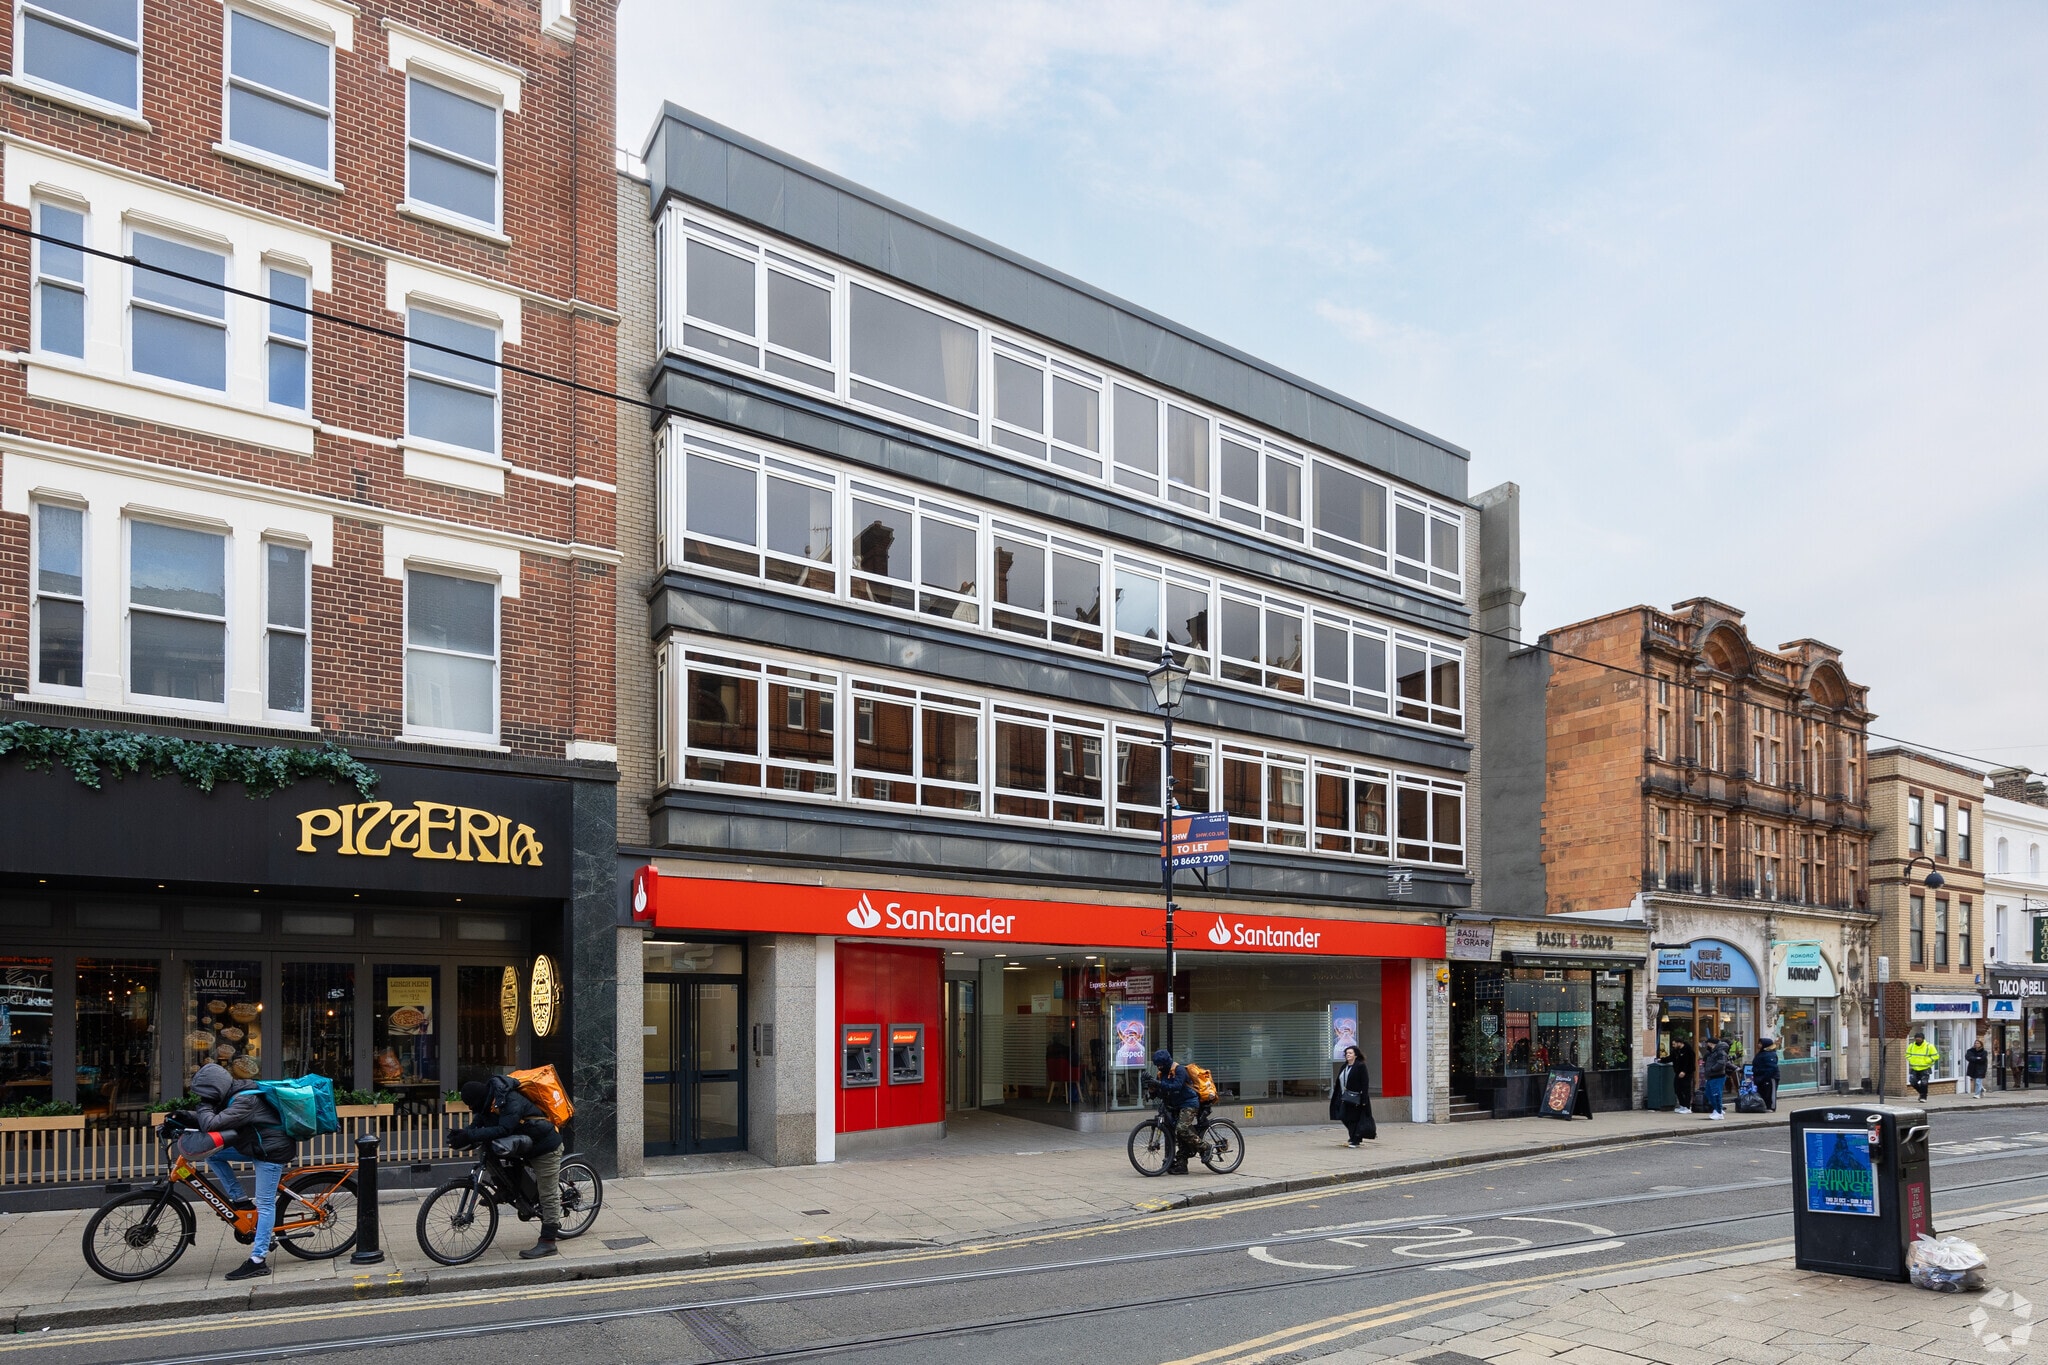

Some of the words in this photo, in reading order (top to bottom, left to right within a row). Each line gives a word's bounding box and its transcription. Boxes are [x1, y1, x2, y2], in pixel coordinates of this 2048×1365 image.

[296, 801, 544, 867] PIZZERIA
[1171, 832, 1188, 841] SHW
[1177, 845, 1190, 854] TO
[1192, 842, 1209, 852] LET
[1180, 856, 1201, 865] 8662
[1202, 854, 1225, 863] 2700
[885, 902, 1016, 934] Santander
[1233, 923, 1321, 948] Santander
[1457, 929, 1479, 938] BASIL
[1463, 938, 1490, 948] GRAPE
[1536, 931, 1567, 948] BASIL
[1570, 932, 1578, 948] &
[1581, 934, 1614, 950] GRAPE
[206, 969, 225, 979] LET
[225, 970, 236, 979] IT
[1690, 960, 1731, 981] NERO
[1788, 966, 1819, 982] KOKORO
[193, 979, 247, 988] SNOW(BALL)
[1108, 980, 1128, 988] Banking
[1998, 980, 2019, 995] TACO
[2028, 981, 2047, 995] BELL
[1117, 1049, 1144, 1059] Respect
[1827, 1112, 1851, 1121] Bigbelly
[199, 1187, 235, 1219] zoomo
